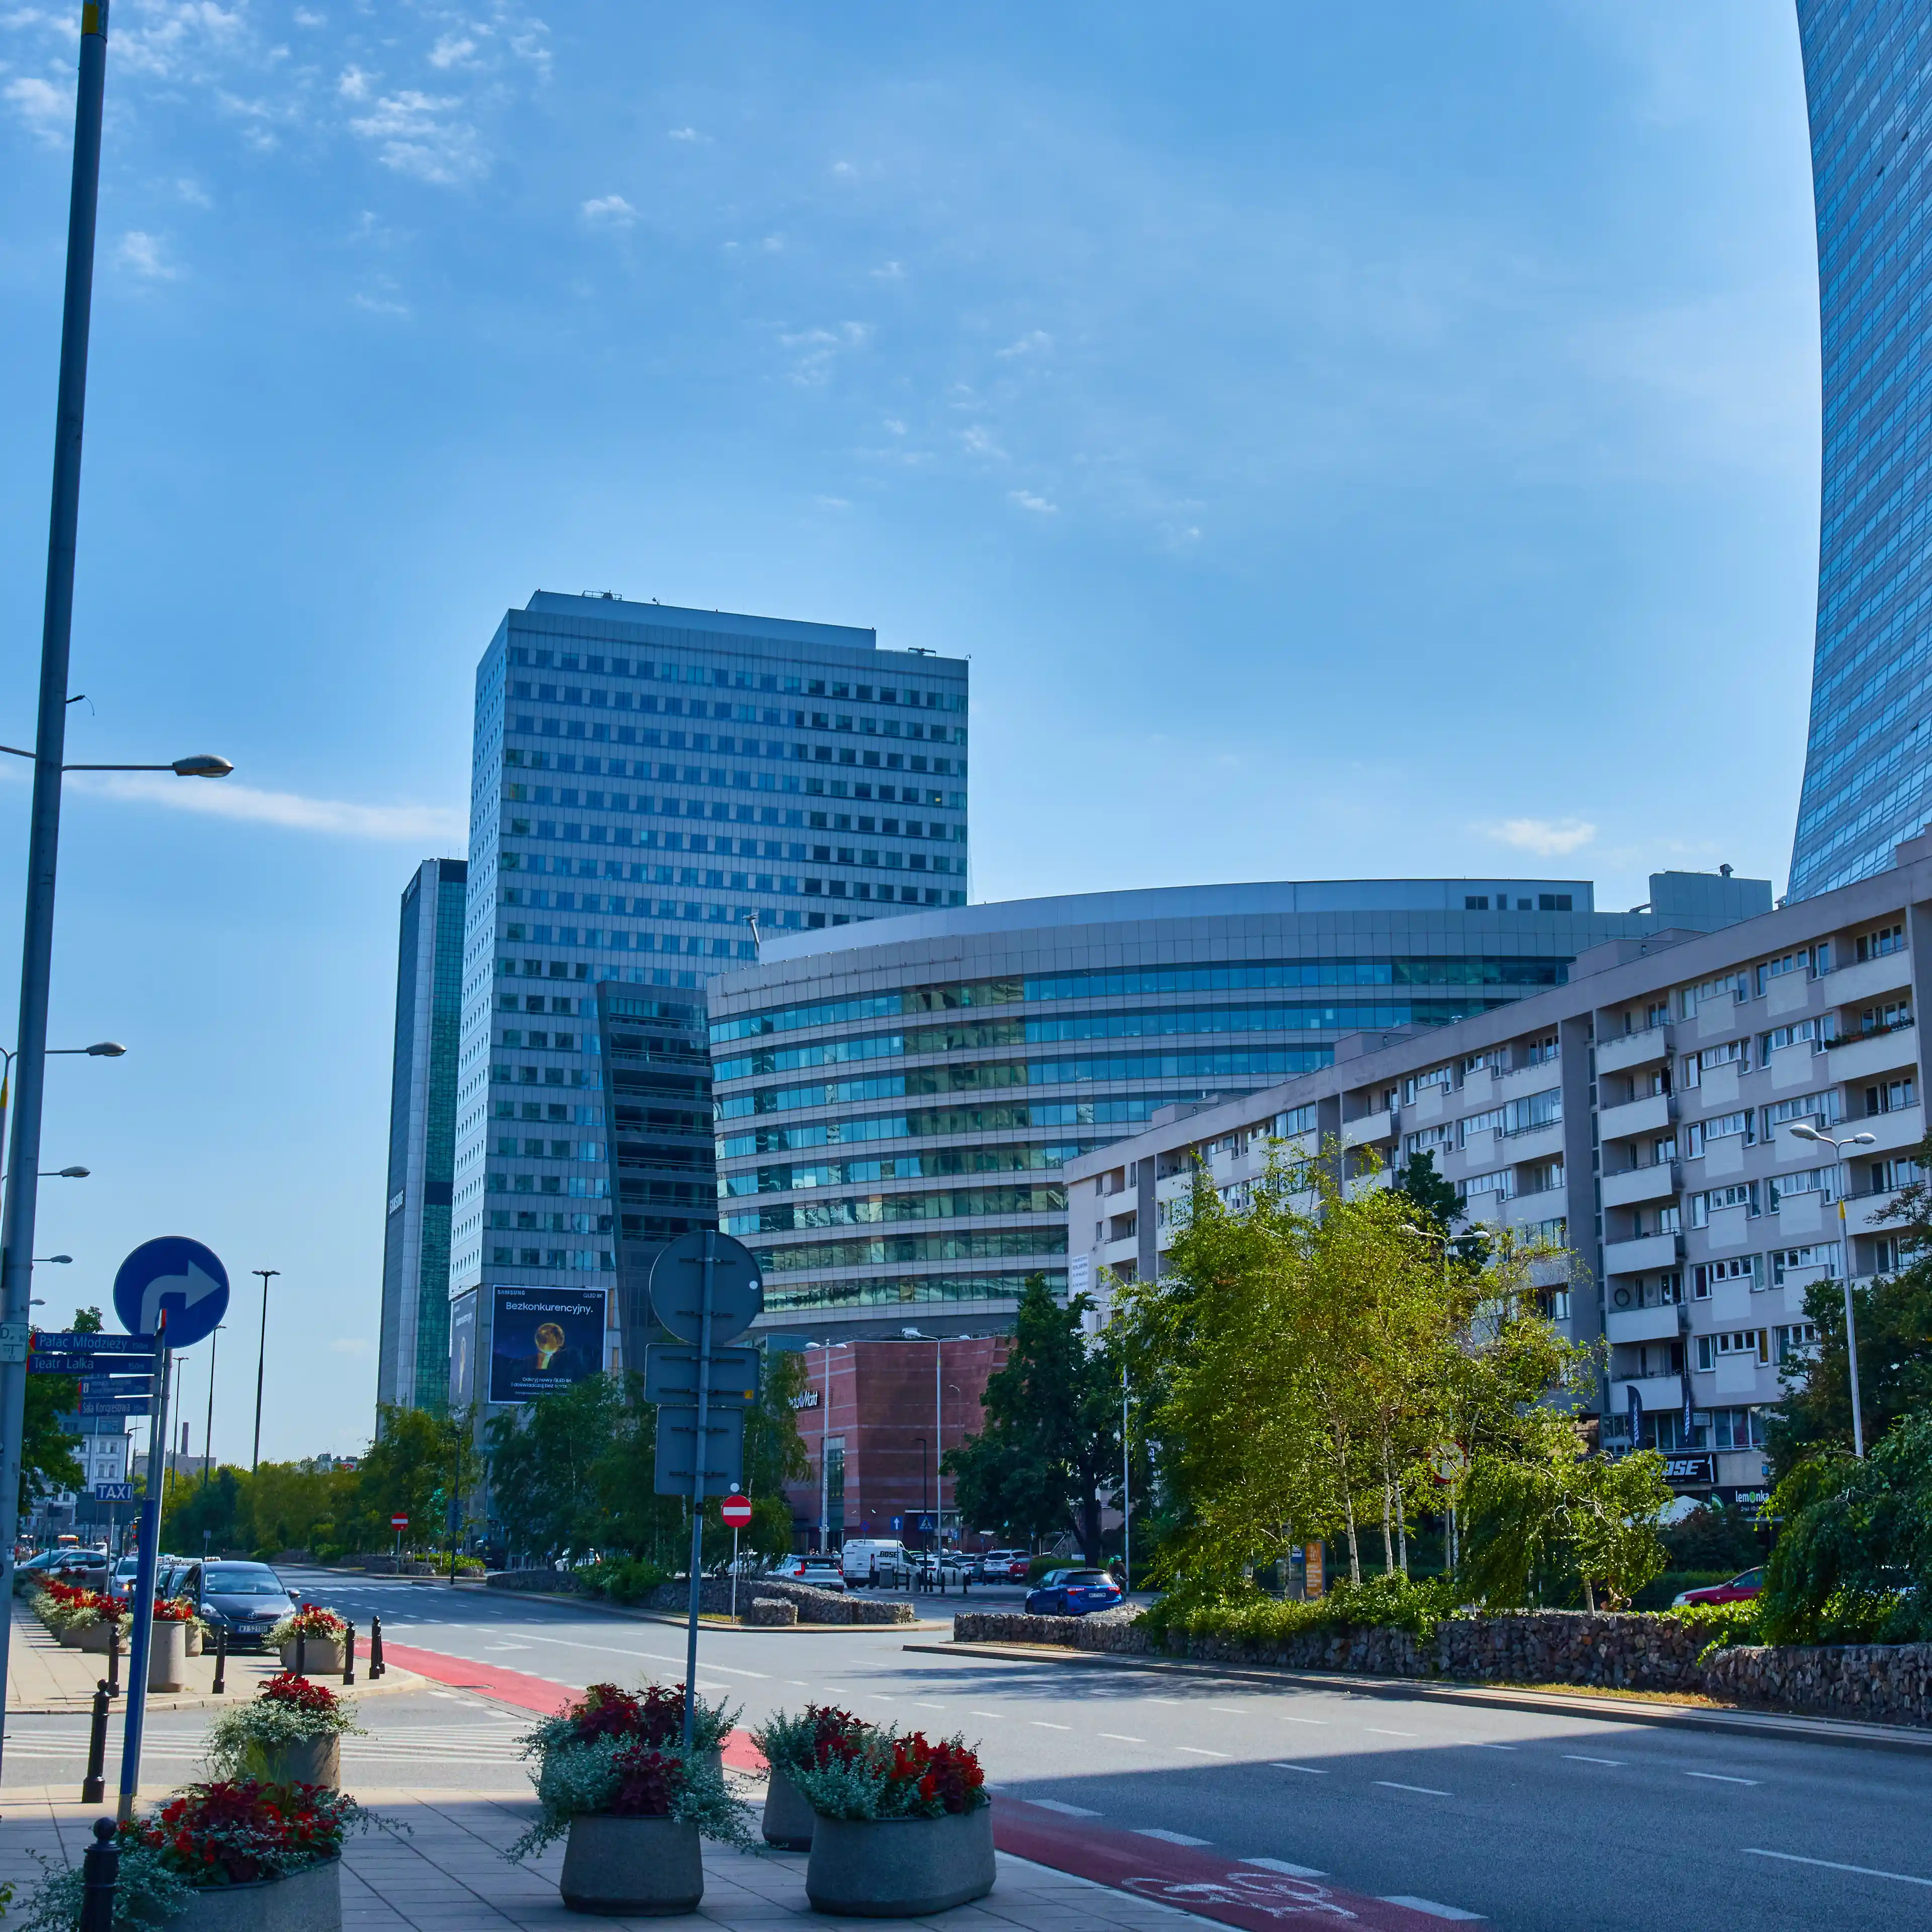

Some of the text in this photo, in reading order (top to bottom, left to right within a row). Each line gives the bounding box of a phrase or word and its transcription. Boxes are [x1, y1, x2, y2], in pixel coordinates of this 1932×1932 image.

[506, 1302, 593, 1315] Bezkonkurencyjny.
[40, 1335, 68, 1347] Pałac
[73, 1336, 127, 1352] Młodzieży
[34, 1357, 61, 1369] Teatr
[66, 1357, 94, 1369] Lalka
[83, 1402, 94, 1413] Sala
[96, 1402, 130, 1415] Kongresowa
[1649, 1460, 1705, 1476] OSE
[98, 1485, 131, 1499] TAXI
[1735, 1489, 1769, 1503] lemonka
